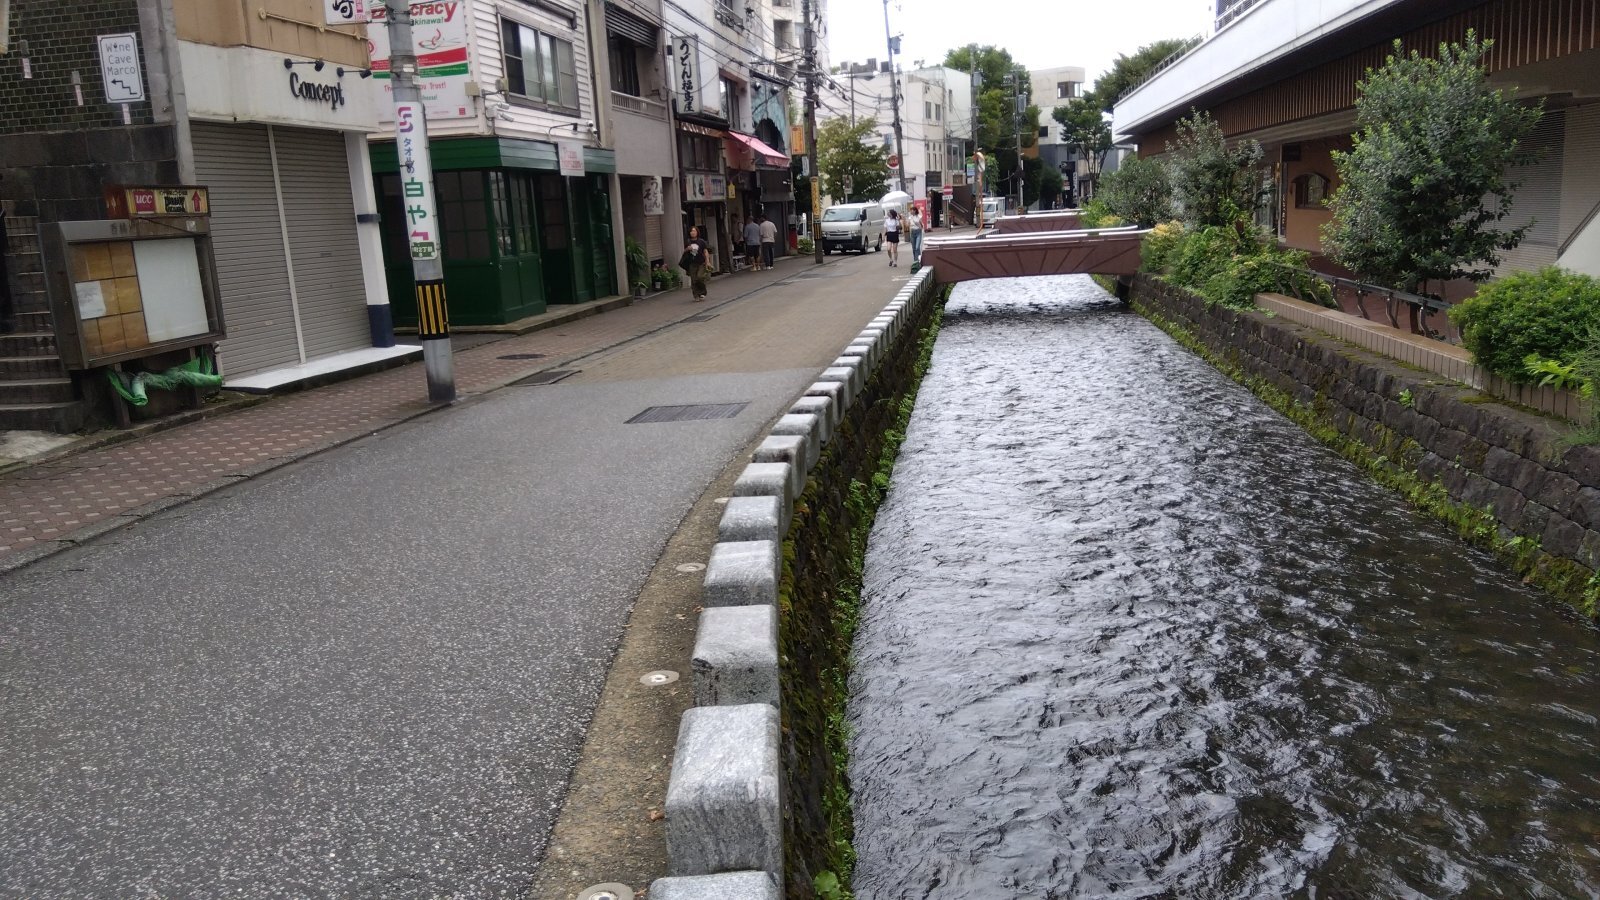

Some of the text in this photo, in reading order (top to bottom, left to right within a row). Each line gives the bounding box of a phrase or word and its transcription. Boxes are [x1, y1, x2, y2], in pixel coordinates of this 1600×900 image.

[106, 42, 131, 52] Wine
[109, 55, 132, 65] Cave
[107, 66, 136, 76] Marco
[289, 72, 345, 111] Concept
[404, 177, 428, 226] 白や
